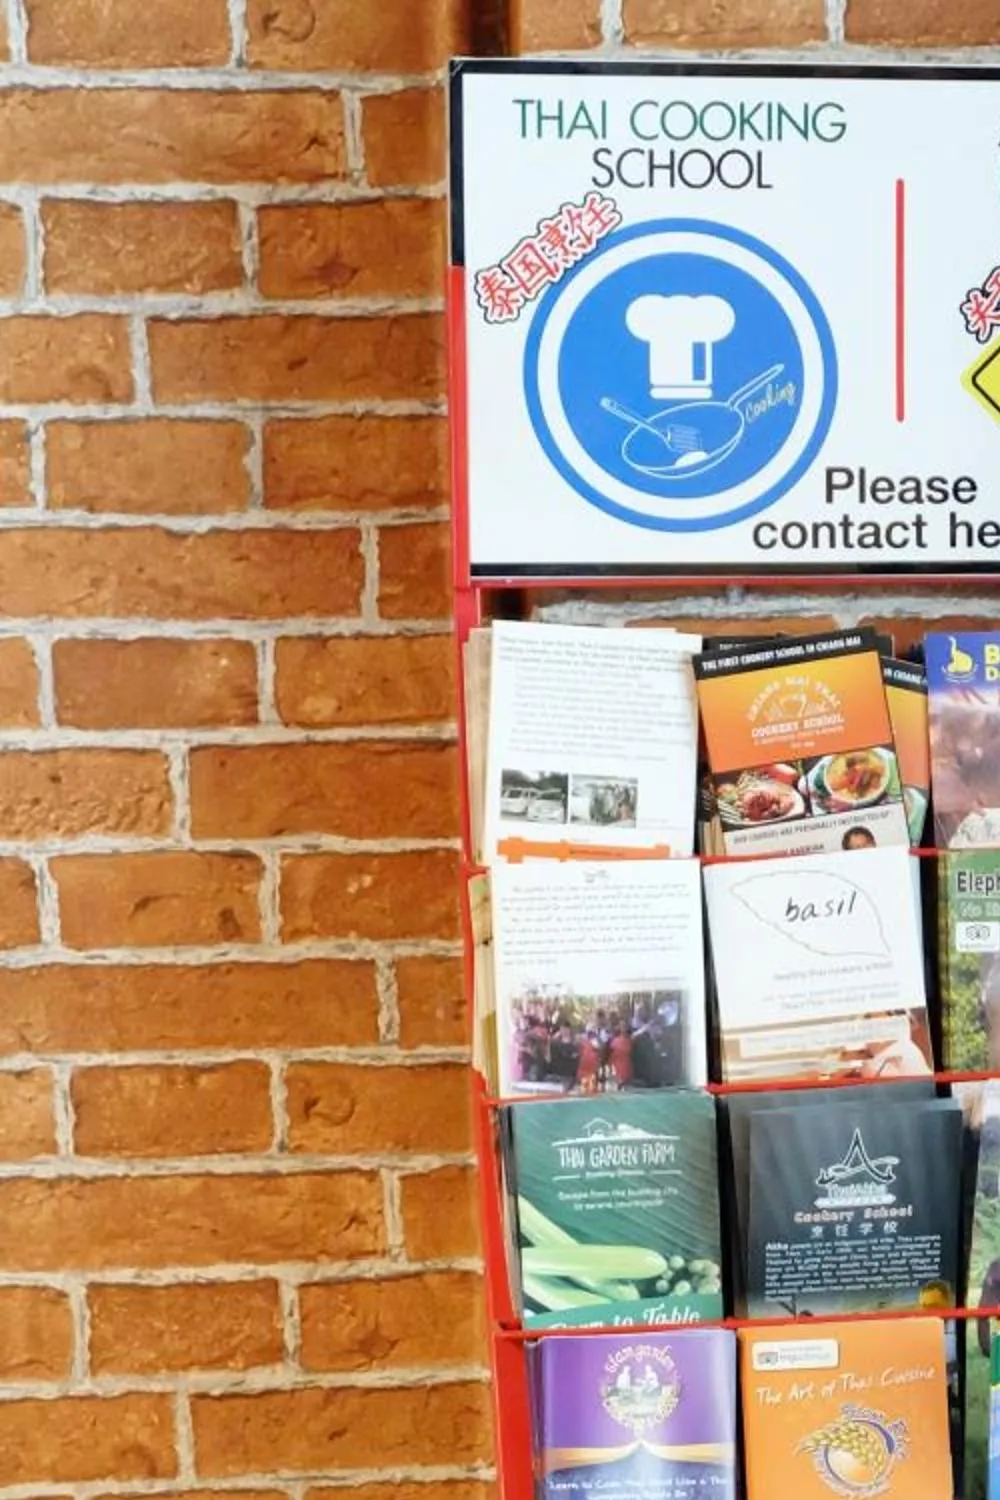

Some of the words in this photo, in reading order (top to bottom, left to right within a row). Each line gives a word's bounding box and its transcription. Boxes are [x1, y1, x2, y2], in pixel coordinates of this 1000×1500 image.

[512, 99, 607, 140] THAI
[629, 100, 847, 142] COOKING
[591, 148, 773, 189] SCHOOL
[825, 466, 978, 504] Please
[752, 513, 928, 550] contact
[785, 890, 856, 922] basil
[590, 1145, 639, 1168] GARDEN
[642, 1142, 675, 1166] FARM
[756, 1387, 781, 1405] The
[789, 1381, 815, 1400] Art
